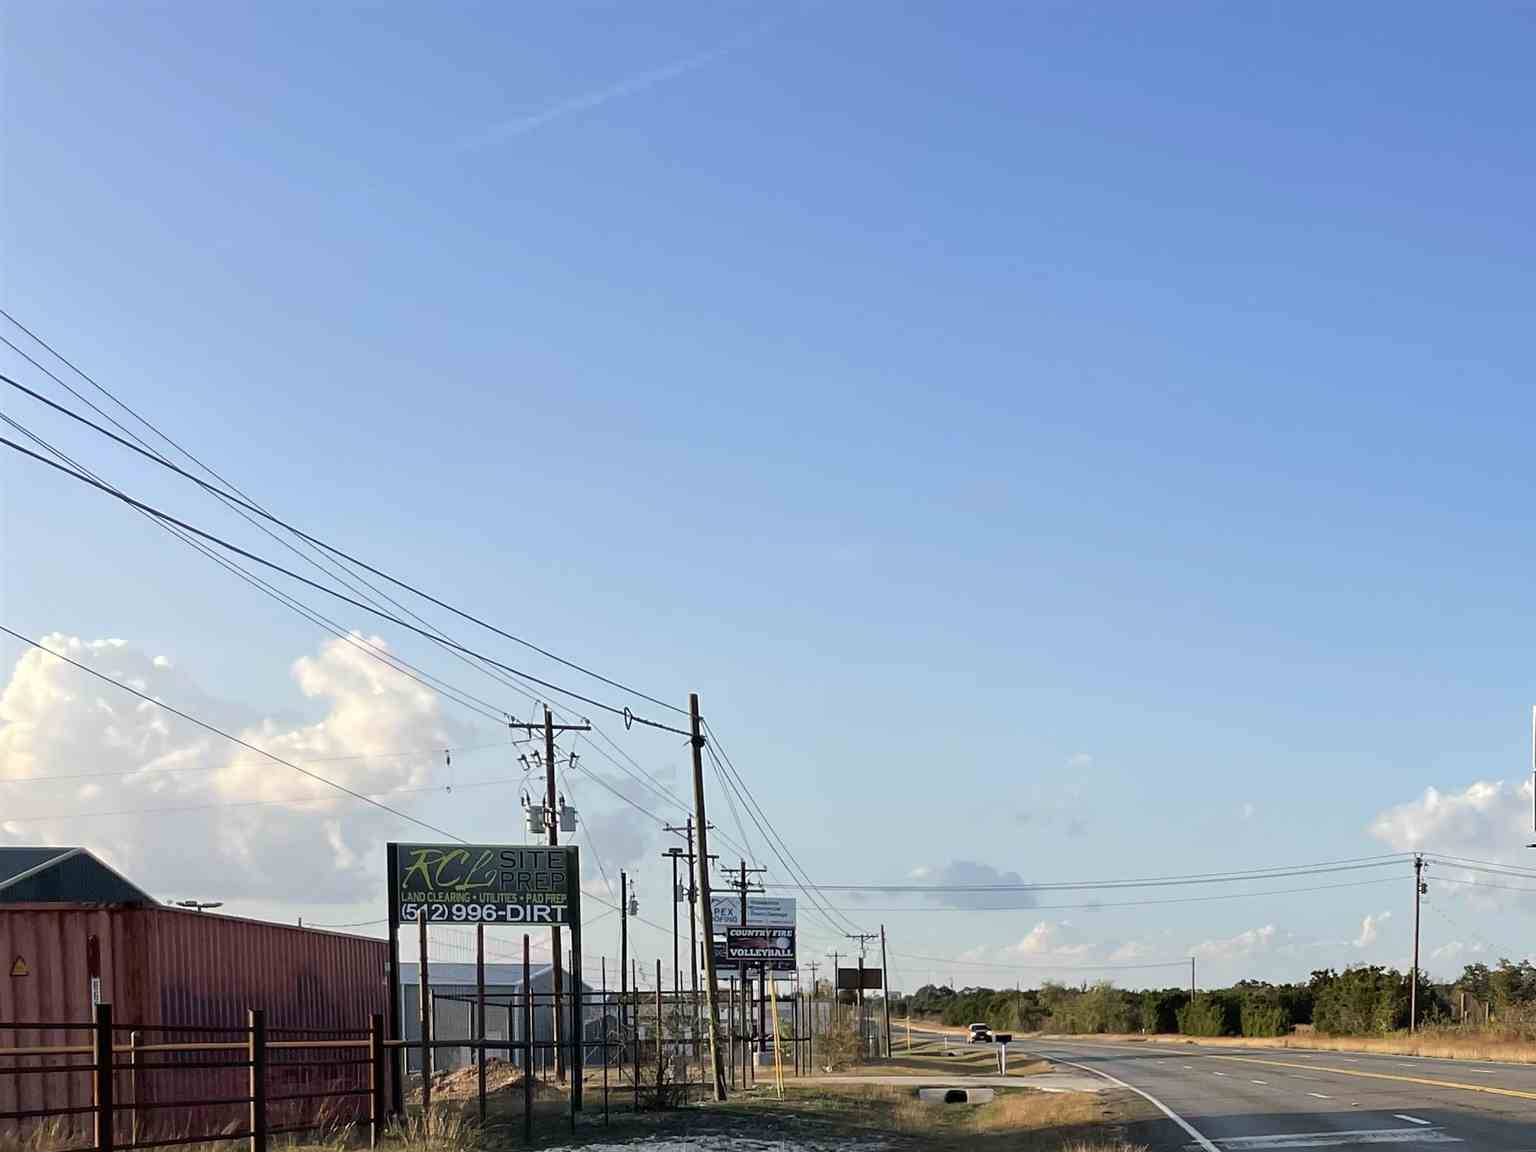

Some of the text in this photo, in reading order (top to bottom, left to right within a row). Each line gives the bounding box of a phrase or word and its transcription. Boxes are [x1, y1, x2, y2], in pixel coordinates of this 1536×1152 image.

[499, 850, 565, 869] SITE
[500, 871, 566, 891] PREP
[401, 891, 567, 904] LAND CLEARING UTILITIES PAD PREP
[401, 903, 568, 922] (512) 996-DIRT
[714, 907, 733, 916] PEX
[730, 929, 793, 937] COUNTRY FIRE
[730, 949, 793, 957] VOLLEYBALL
